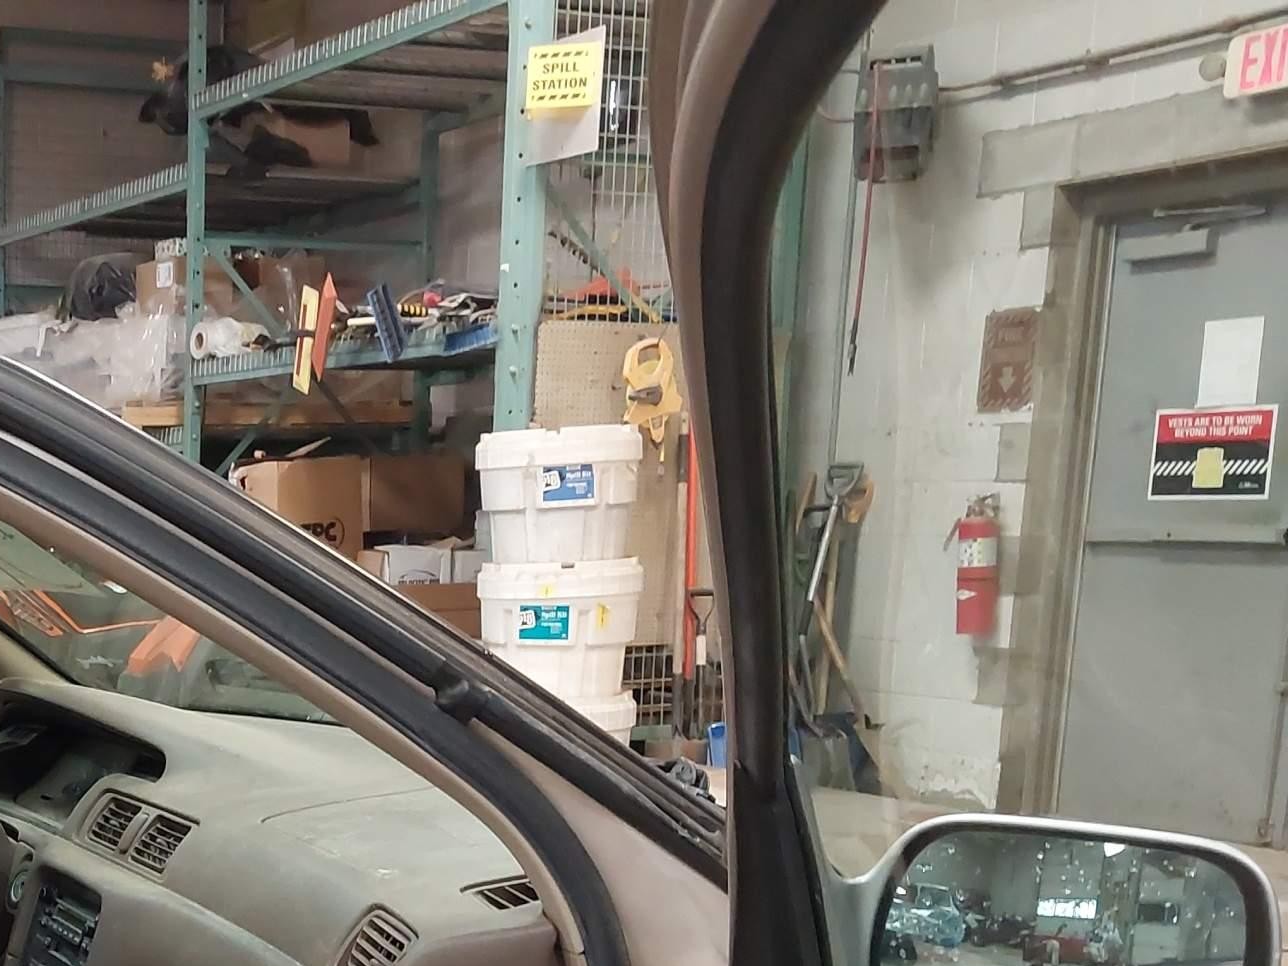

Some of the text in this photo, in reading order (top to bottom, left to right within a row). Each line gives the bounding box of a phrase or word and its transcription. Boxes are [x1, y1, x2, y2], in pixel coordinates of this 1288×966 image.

[1240, 28, 1288, 89] EXI
[542, 62, 579, 74] SPILL
[532, 77, 587, 91] STATION
[1168, 414, 1263, 428] VESTS ARE TO BE WORN
[1175, 425, 1253, 438] BEYOND THIS POINT
